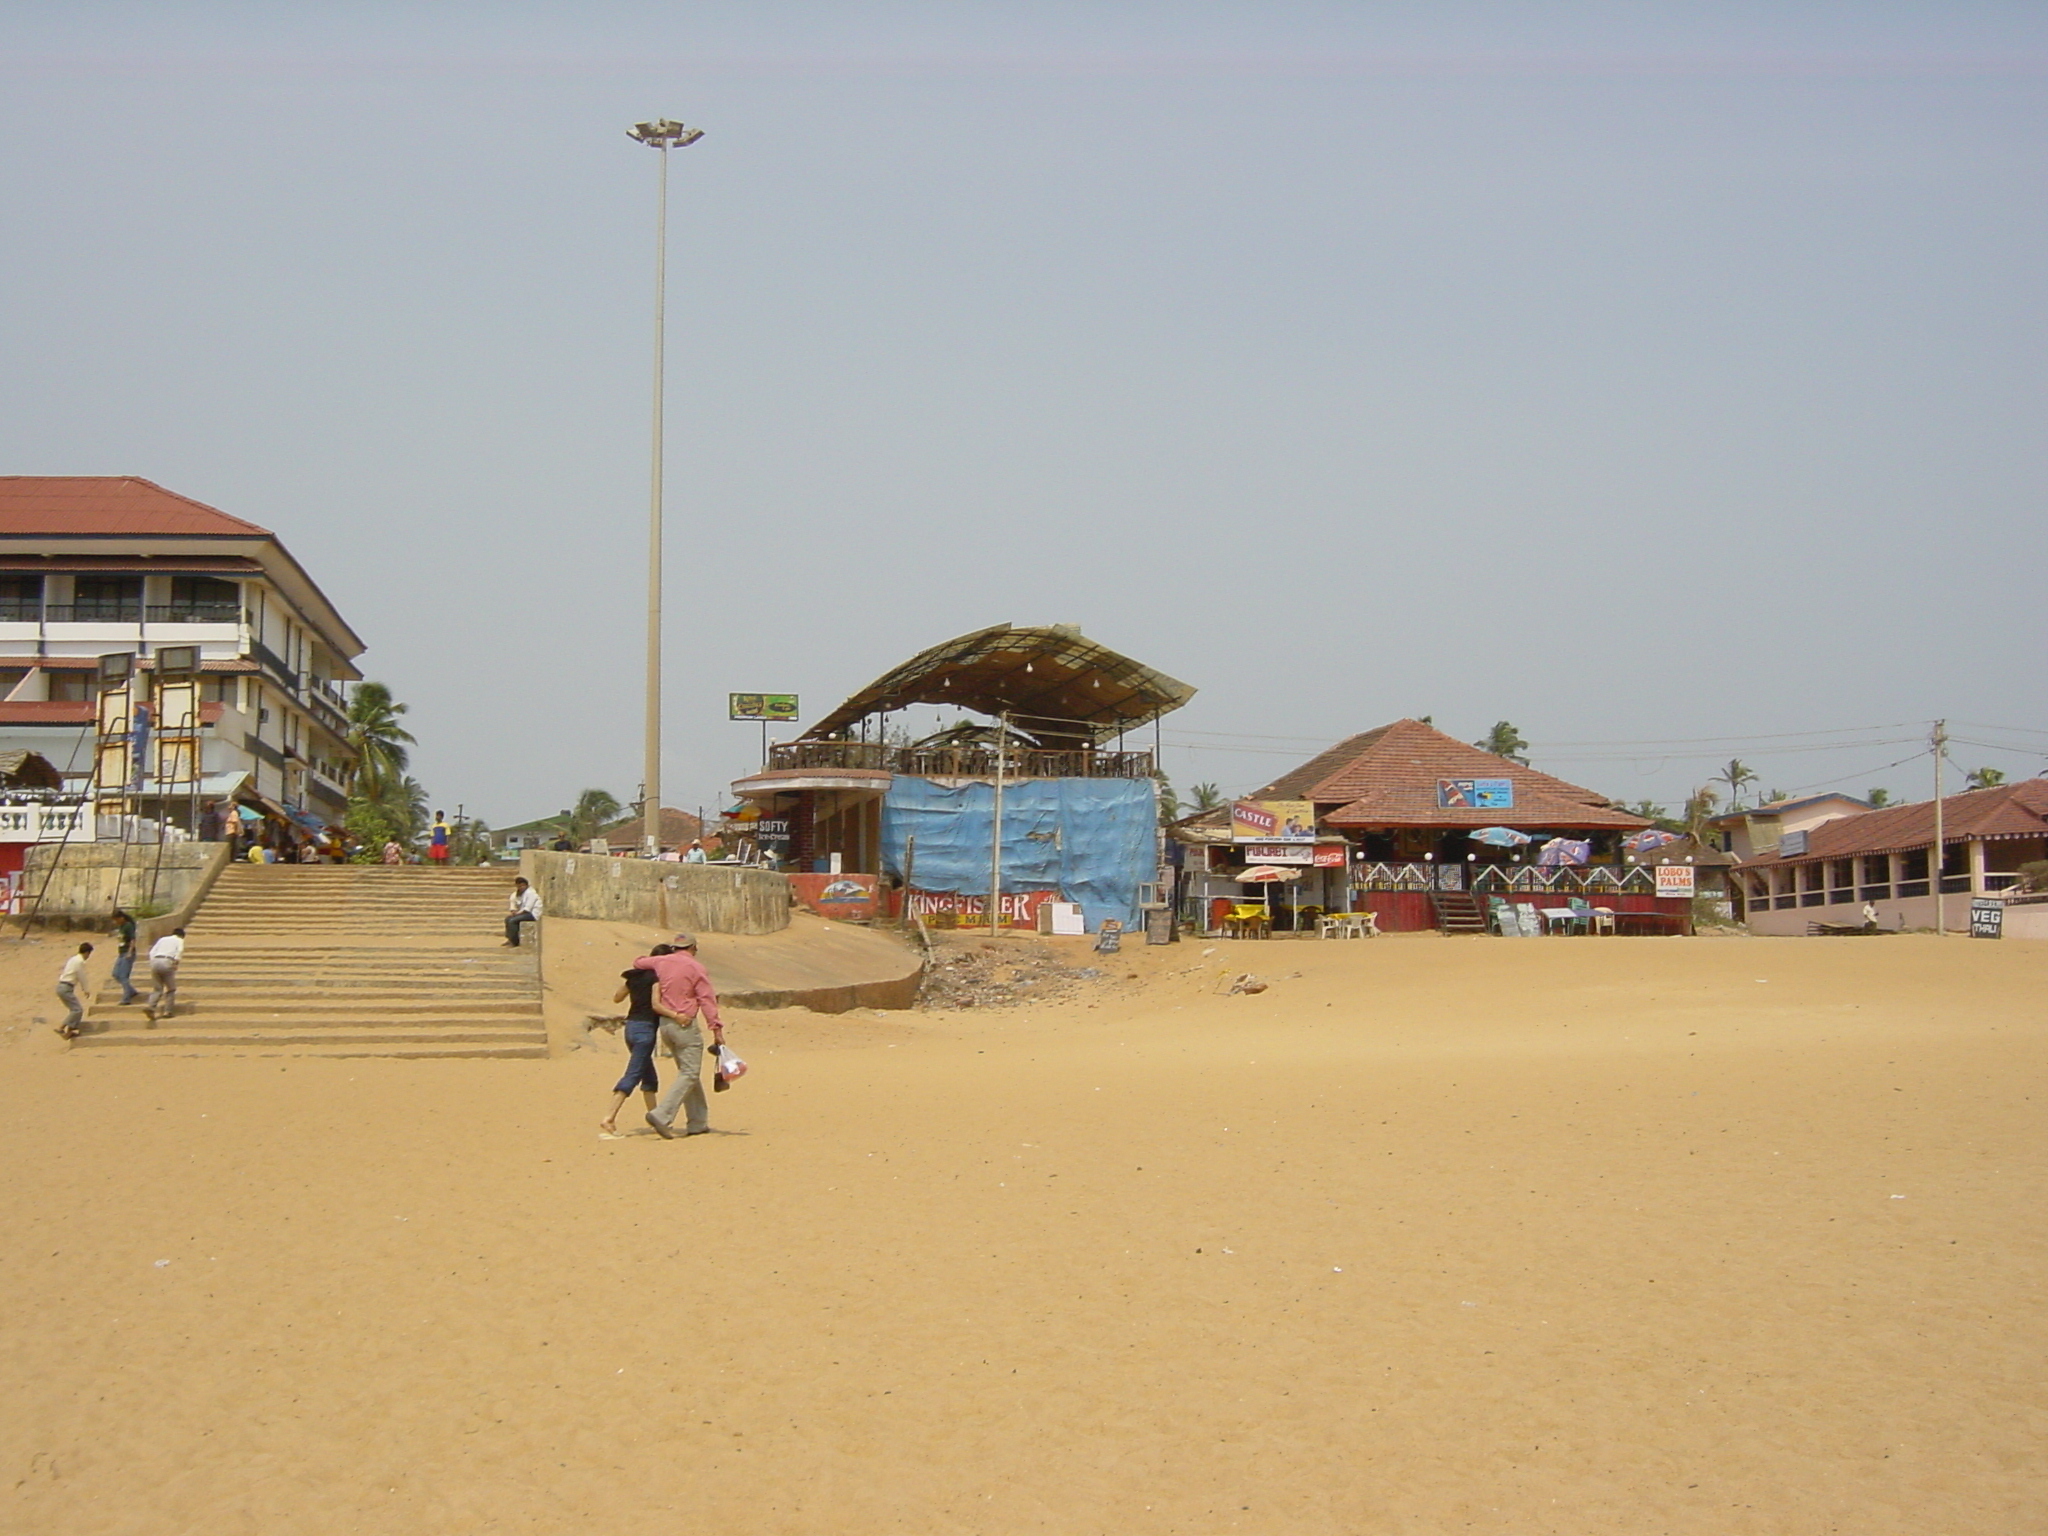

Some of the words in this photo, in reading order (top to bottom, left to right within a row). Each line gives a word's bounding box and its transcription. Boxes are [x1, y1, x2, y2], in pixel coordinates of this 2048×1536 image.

[1234, 808, 1272, 828] CASTLE
[759, 820, 788, 832] SOFTY
[1658, 867, 1691, 876] LOBO'S
[1660, 877, 1692, 887] PALMS
[1971, 909, 2001, 924] VEG
